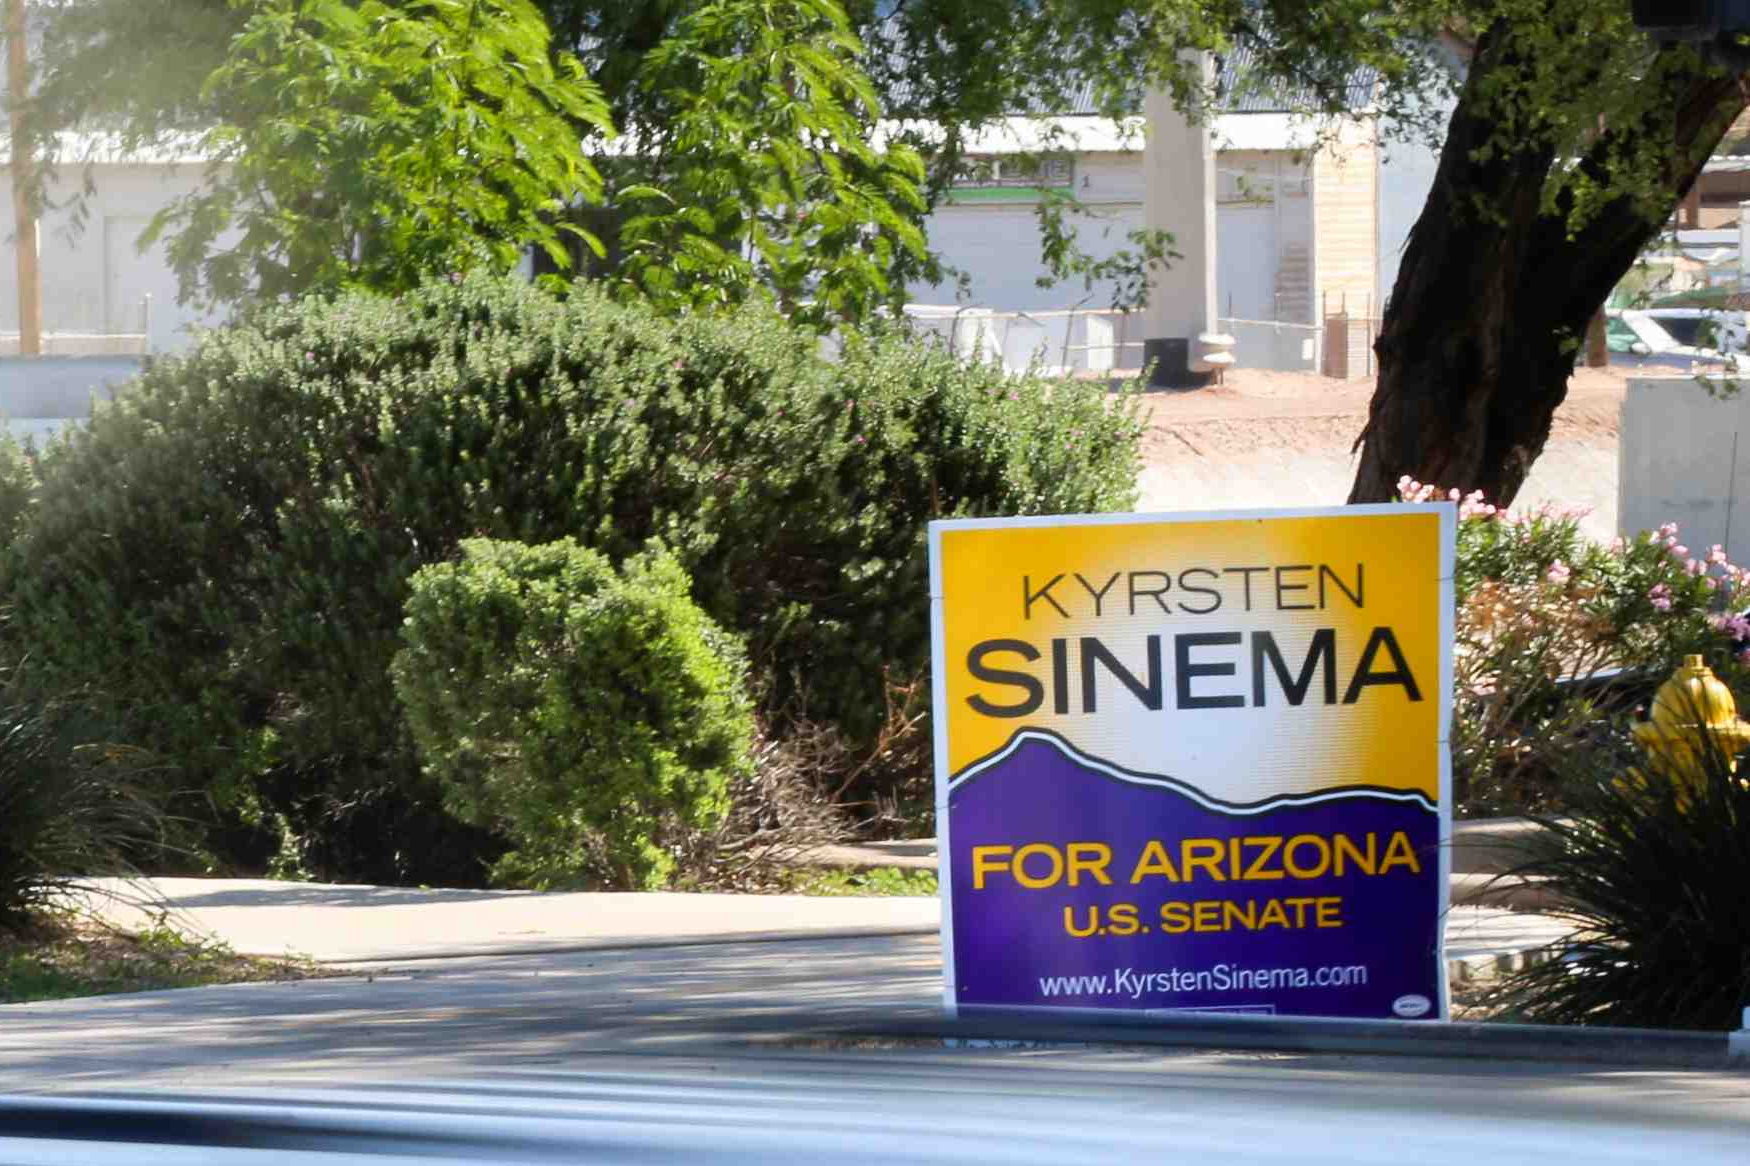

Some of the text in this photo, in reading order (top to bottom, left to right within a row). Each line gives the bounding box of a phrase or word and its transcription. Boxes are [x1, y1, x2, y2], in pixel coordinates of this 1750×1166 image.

[1023, 563, 1365, 620] KYRSTEN
[965, 626, 1424, 718] SINEMA
[972, 831, 1421, 889] FOR ARIZONA
[1064, 897, 1344, 937] U.S. SENATE
[1039, 964, 1368, 999] www.KyrstenSinema.com
